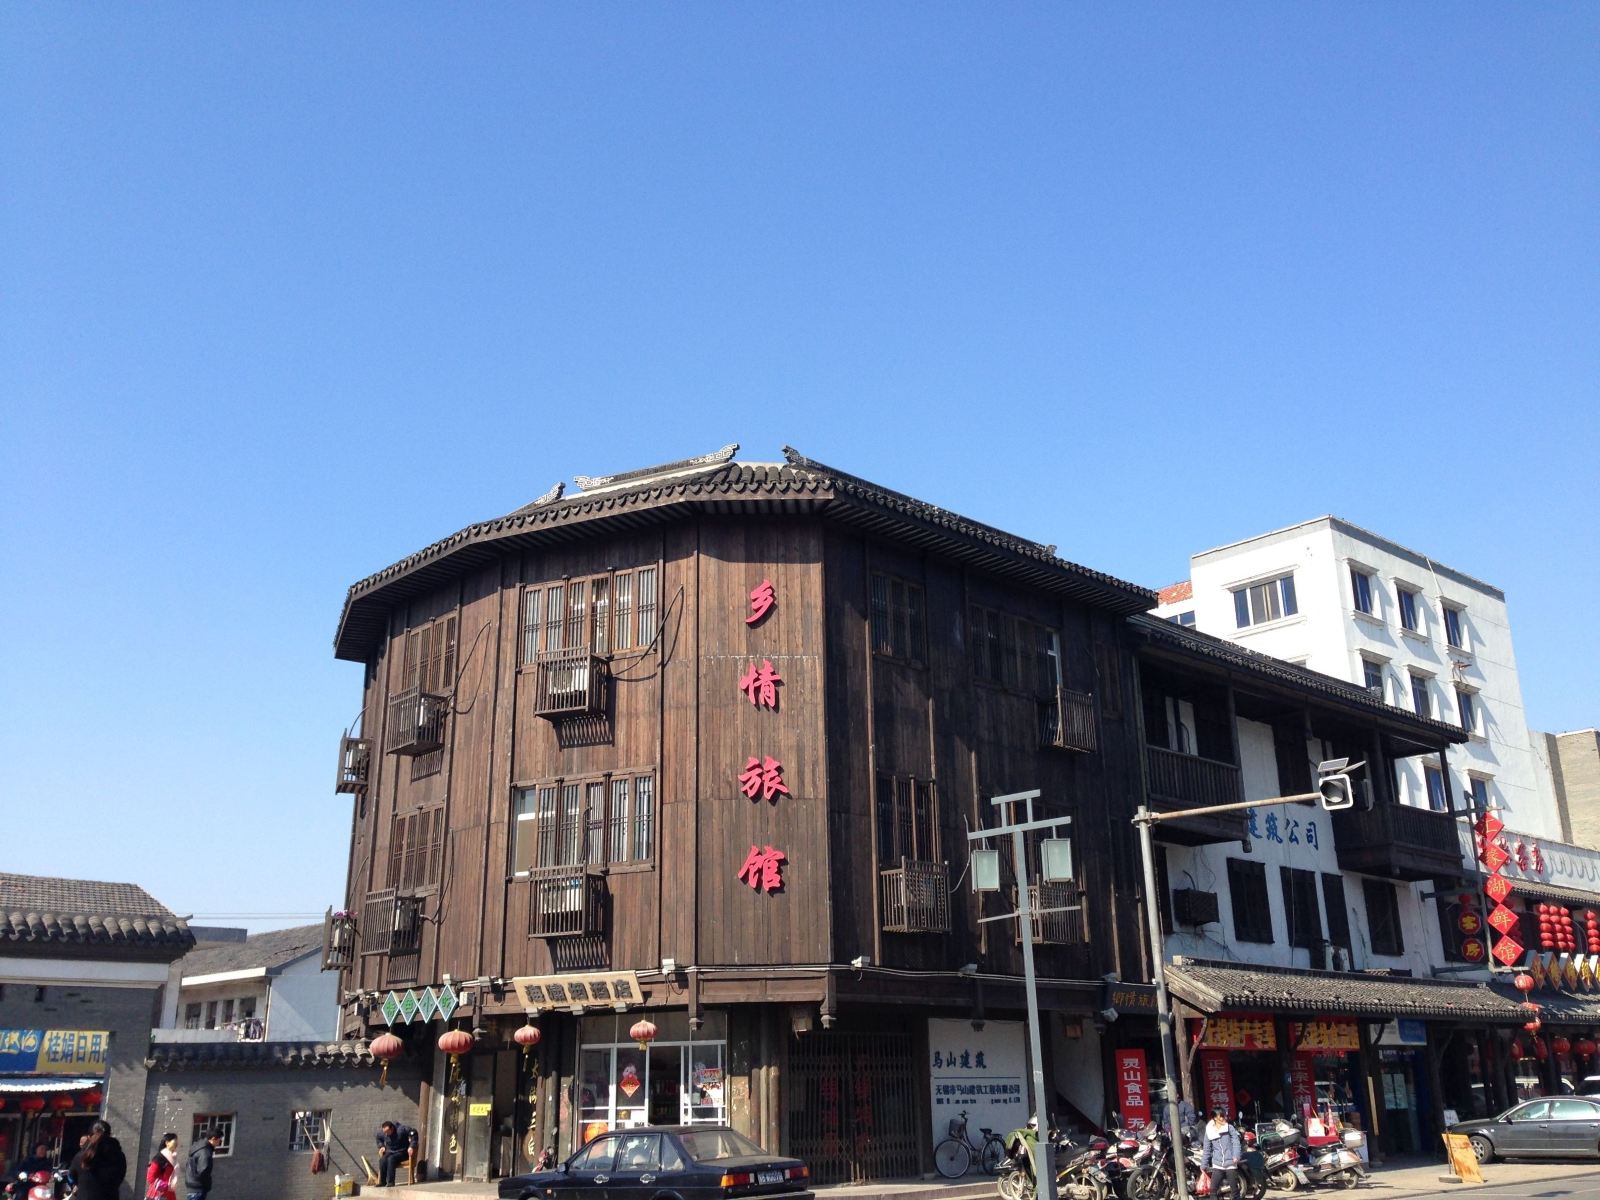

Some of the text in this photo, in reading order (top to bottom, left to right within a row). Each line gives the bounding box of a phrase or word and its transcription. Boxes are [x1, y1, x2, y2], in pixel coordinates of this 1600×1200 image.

[738, 579, 789, 891] 乡情旅馆
[932, 1048, 987, 1069] 马山建筑
[935, 1084, 1020, 1096] 无锡市马山建筑工程有限公司
[1122, 1057, 1144, 1107] 灵山食品
